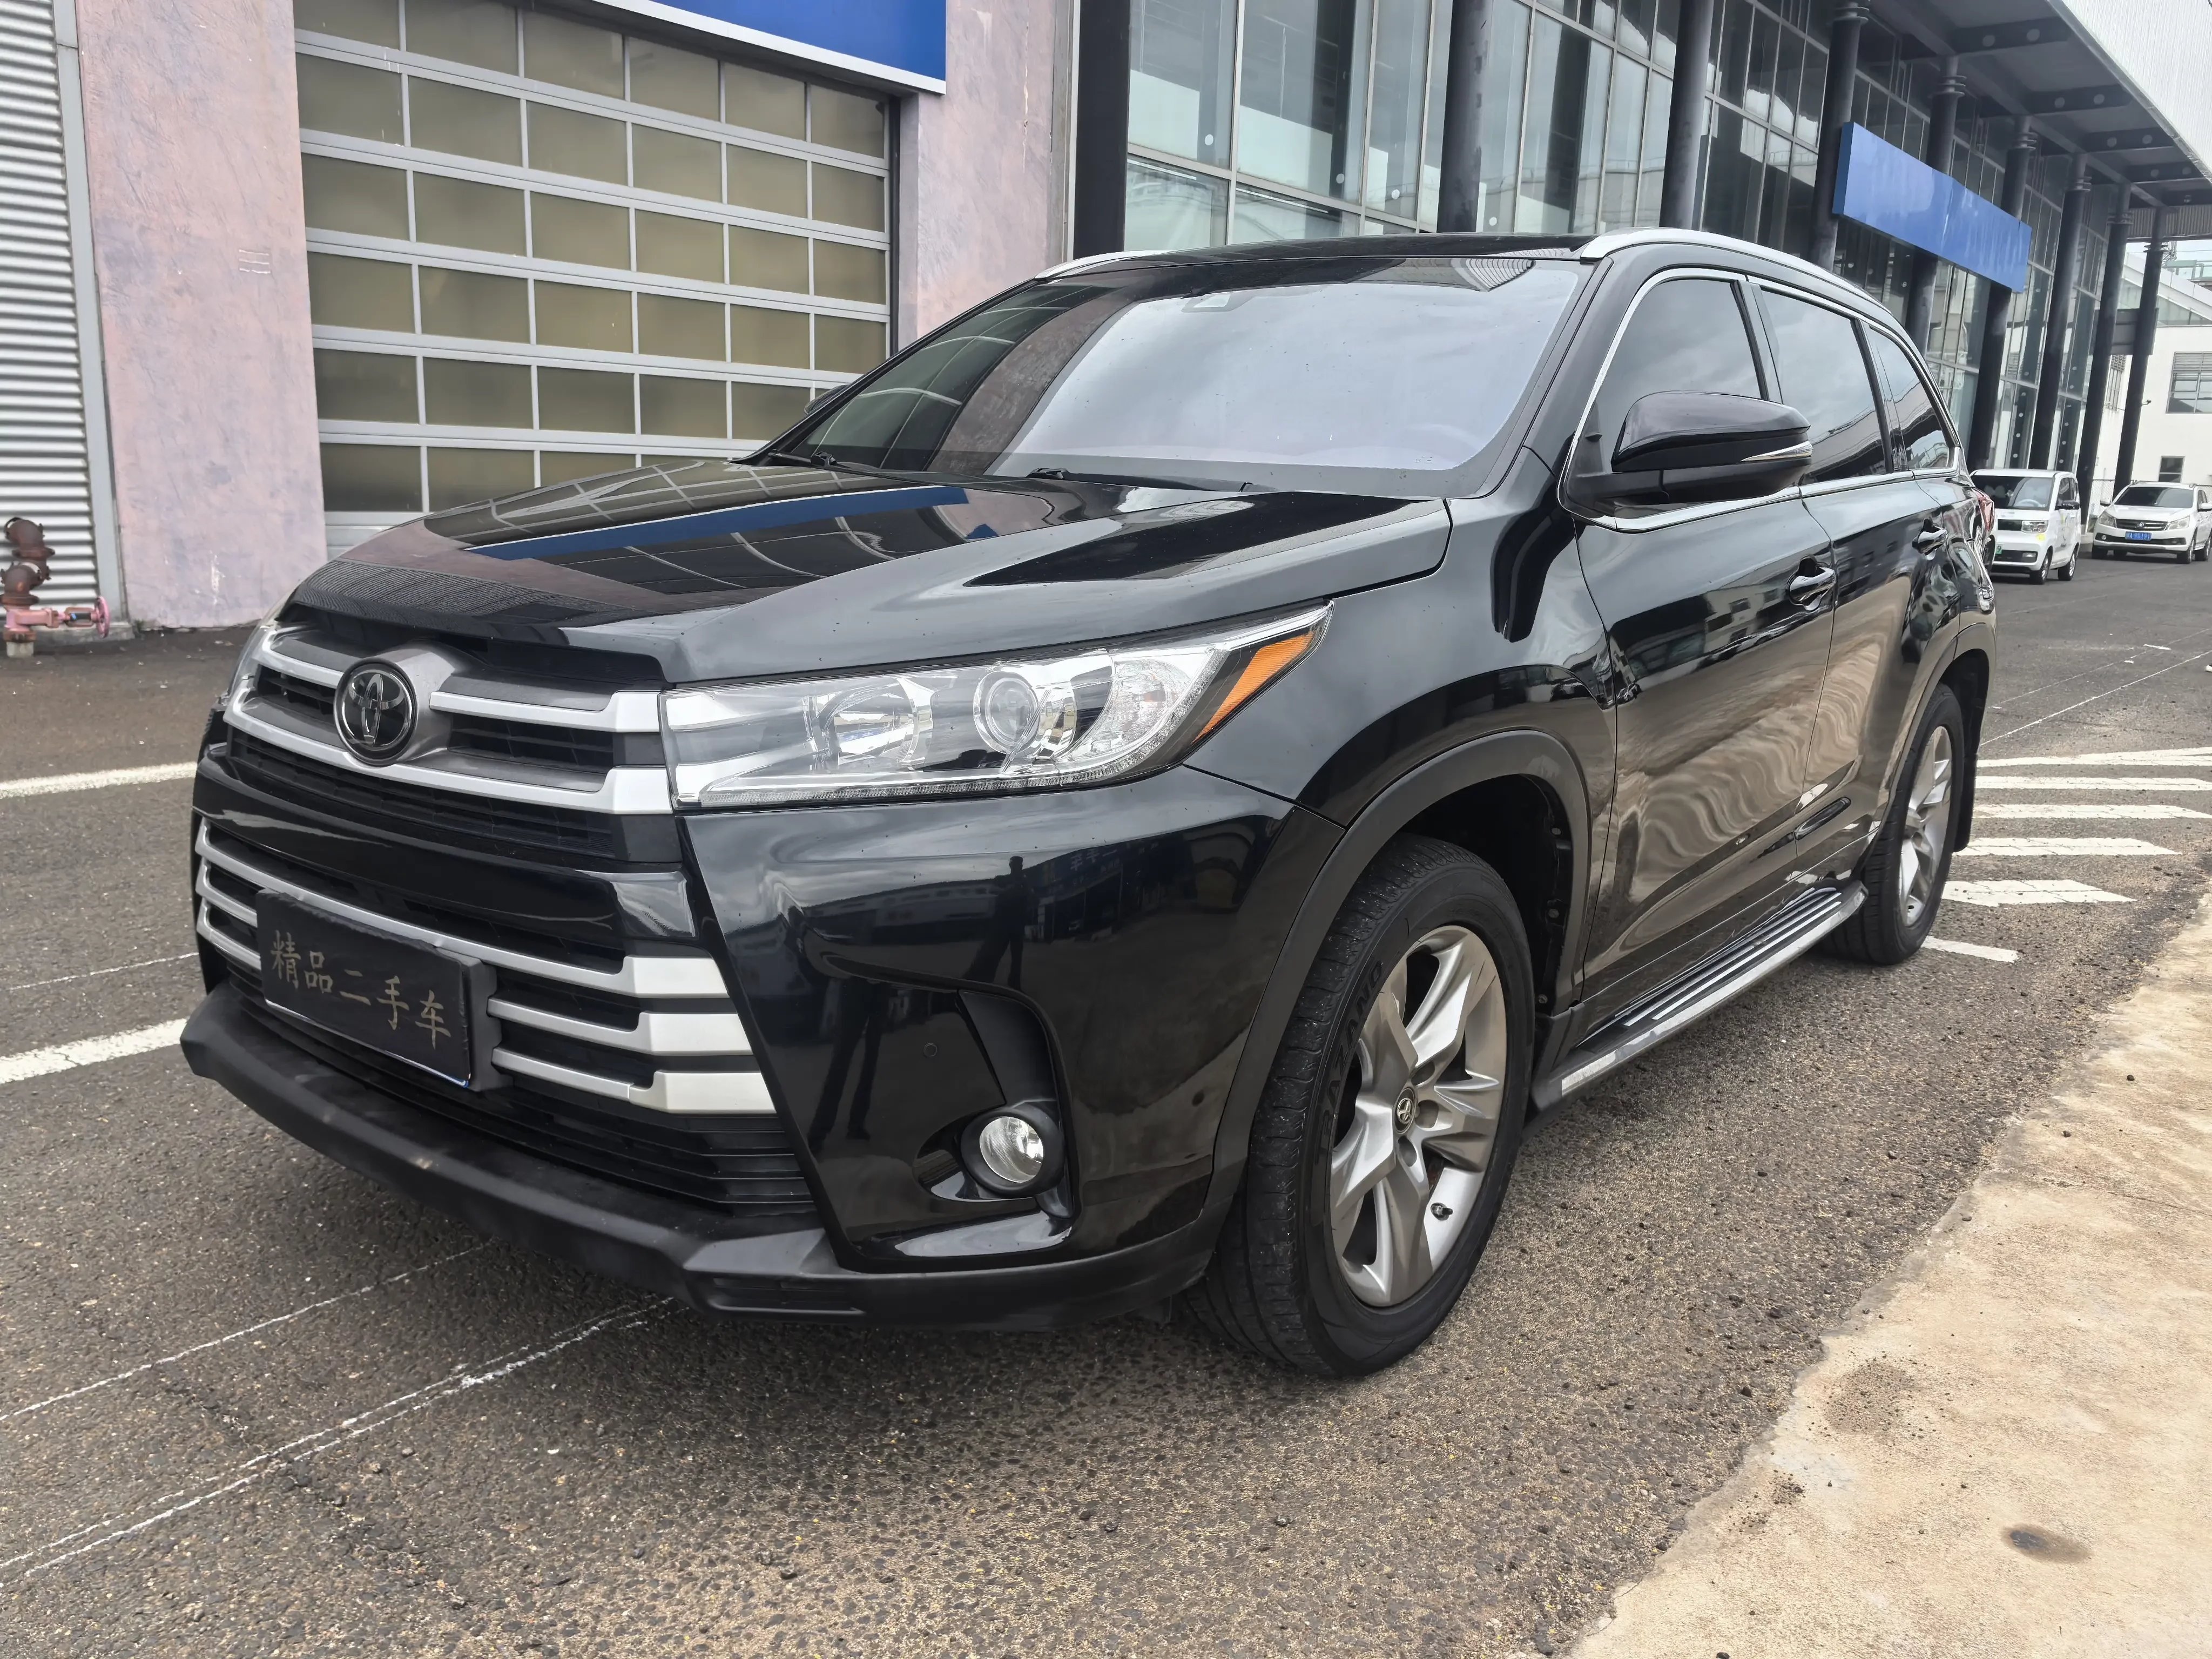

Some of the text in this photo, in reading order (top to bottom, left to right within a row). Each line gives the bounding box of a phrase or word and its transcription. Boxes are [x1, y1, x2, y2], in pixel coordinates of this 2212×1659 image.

[271, 930, 451, 1049] 精品二手车
